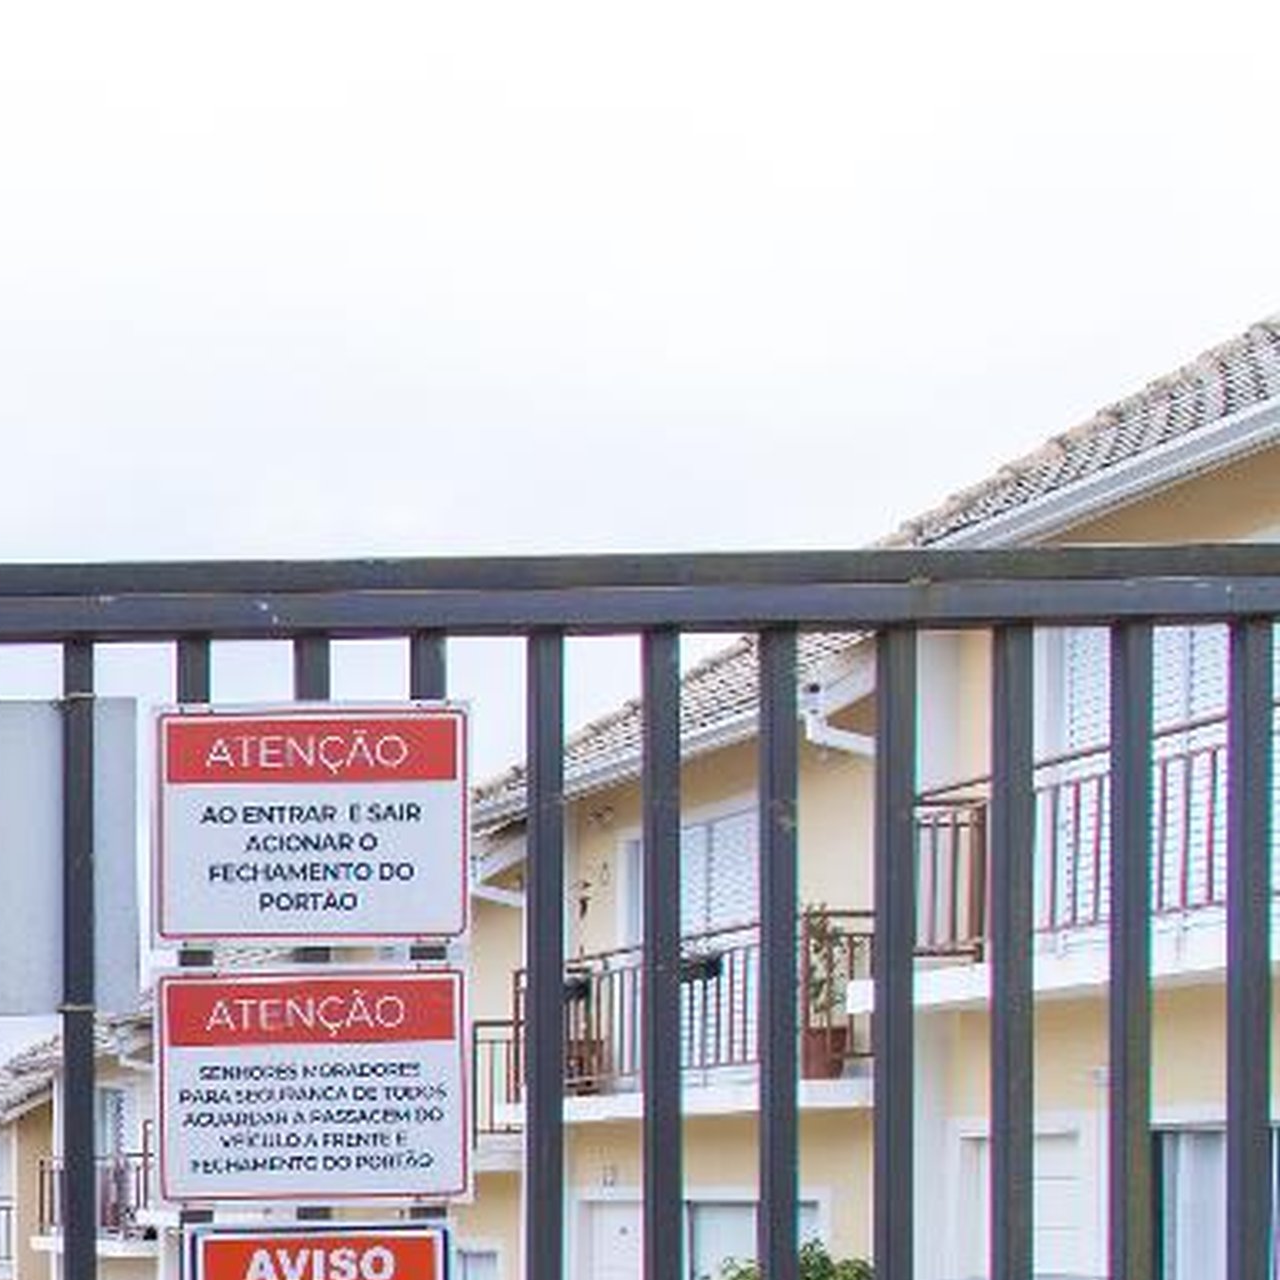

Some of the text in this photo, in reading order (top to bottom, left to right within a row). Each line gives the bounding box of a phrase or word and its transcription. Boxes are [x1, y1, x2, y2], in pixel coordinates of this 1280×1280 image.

[206, 730, 408, 774] ATENÇÃO
[200, 803, 421, 824] AO ENTRAR E SAIR
[246, 834, 378, 852] ACIONAR O
[209, 863, 414, 882] FECHAMENTO DO
[259, 890, 358, 912] PORTÃO
[206, 989, 405, 1036] ATENÇÃO
[199, 1062, 421, 1081] SENHORES MORADORES
[179, 1088, 231, 1104] PARA
[353, 1086, 377, 1101] DE
[385, 1083, 448, 1101] TODOS
[182, 1111, 288, 1127] AGUARDAR
[310, 1109, 411, 1124] PASSAGEM
[415, 1107, 444, 1123] DO
[322, 1132, 390, 1147] FRENTE
[396, 1131, 408, 1146] E
[190, 1150, 434, 1174] FECHAMENTO DO PORTÃO
